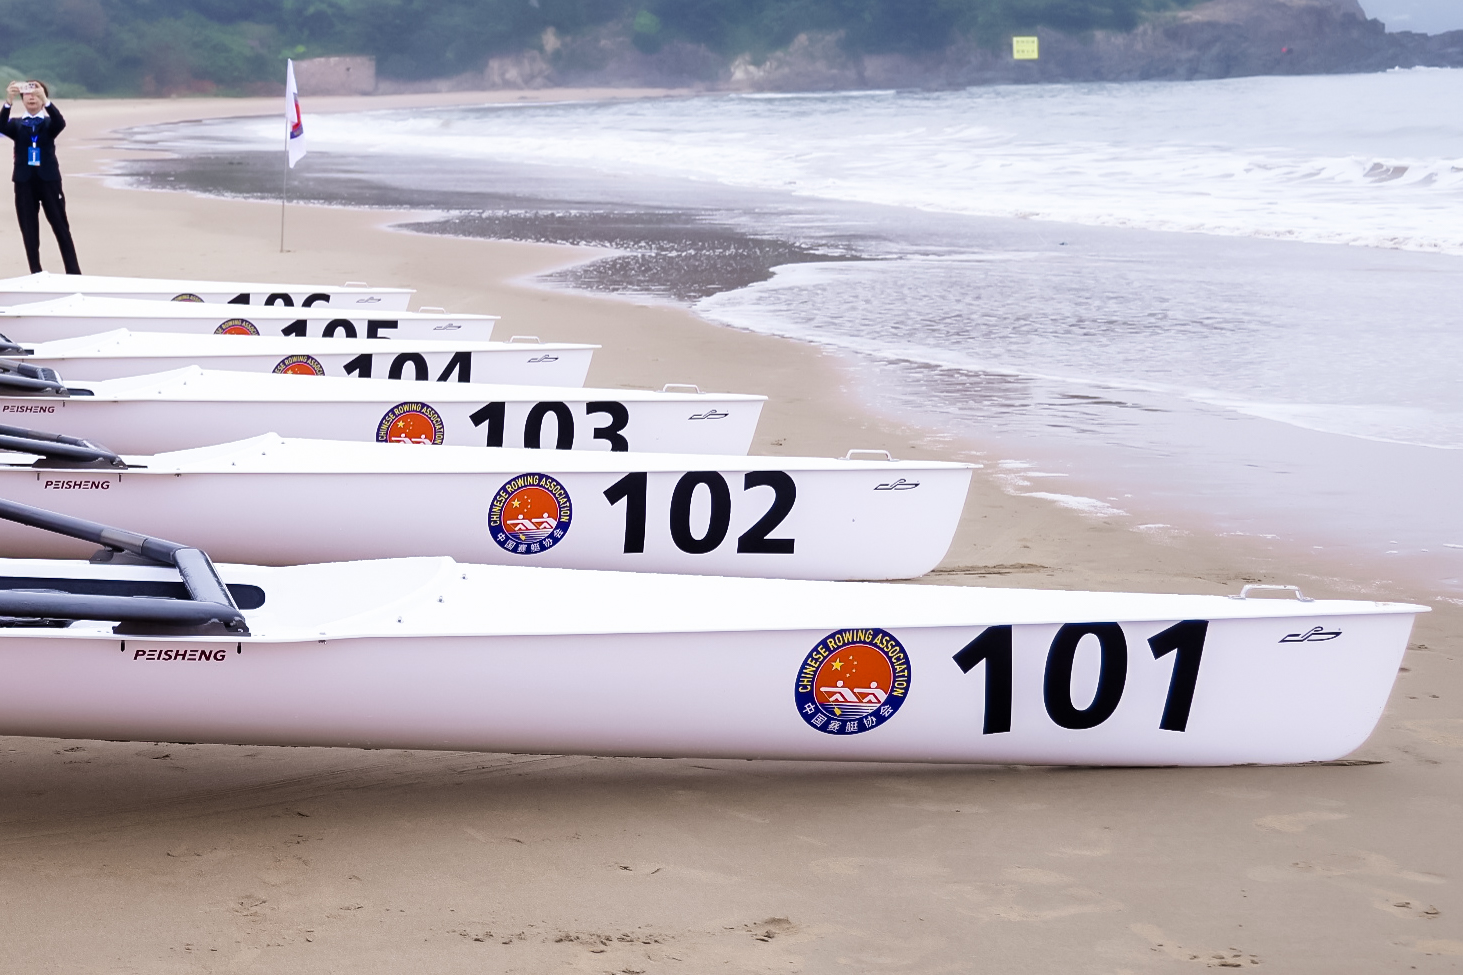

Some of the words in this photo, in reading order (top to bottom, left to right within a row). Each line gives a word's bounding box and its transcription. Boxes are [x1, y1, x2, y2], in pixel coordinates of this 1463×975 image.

[2, 405, 55, 414] PEISHENG
[378, 412, 396, 441] CHINESE
[393, 403, 422, 415] ROWING
[421, 406, 444, 445] ASSOCIATION
[468, 401, 630, 453] 103
[44, 480, 110, 490] PEISHENG
[490, 490, 509, 526] CHINESE
[505, 475, 539, 493] ROWING
[539, 477, 570, 523] ASSOCIATION
[602, 470, 797, 554] 102
[133, 649, 227, 662] PEISHENG
[798, 644, 829, 693] CHINESE
[826, 629, 874, 651] ROWING
[873, 633, 908, 697] ASSOCIATION
[951, 619, 1210, 735] 101
[802, 702, 894, 733] 中国赛艇协会
